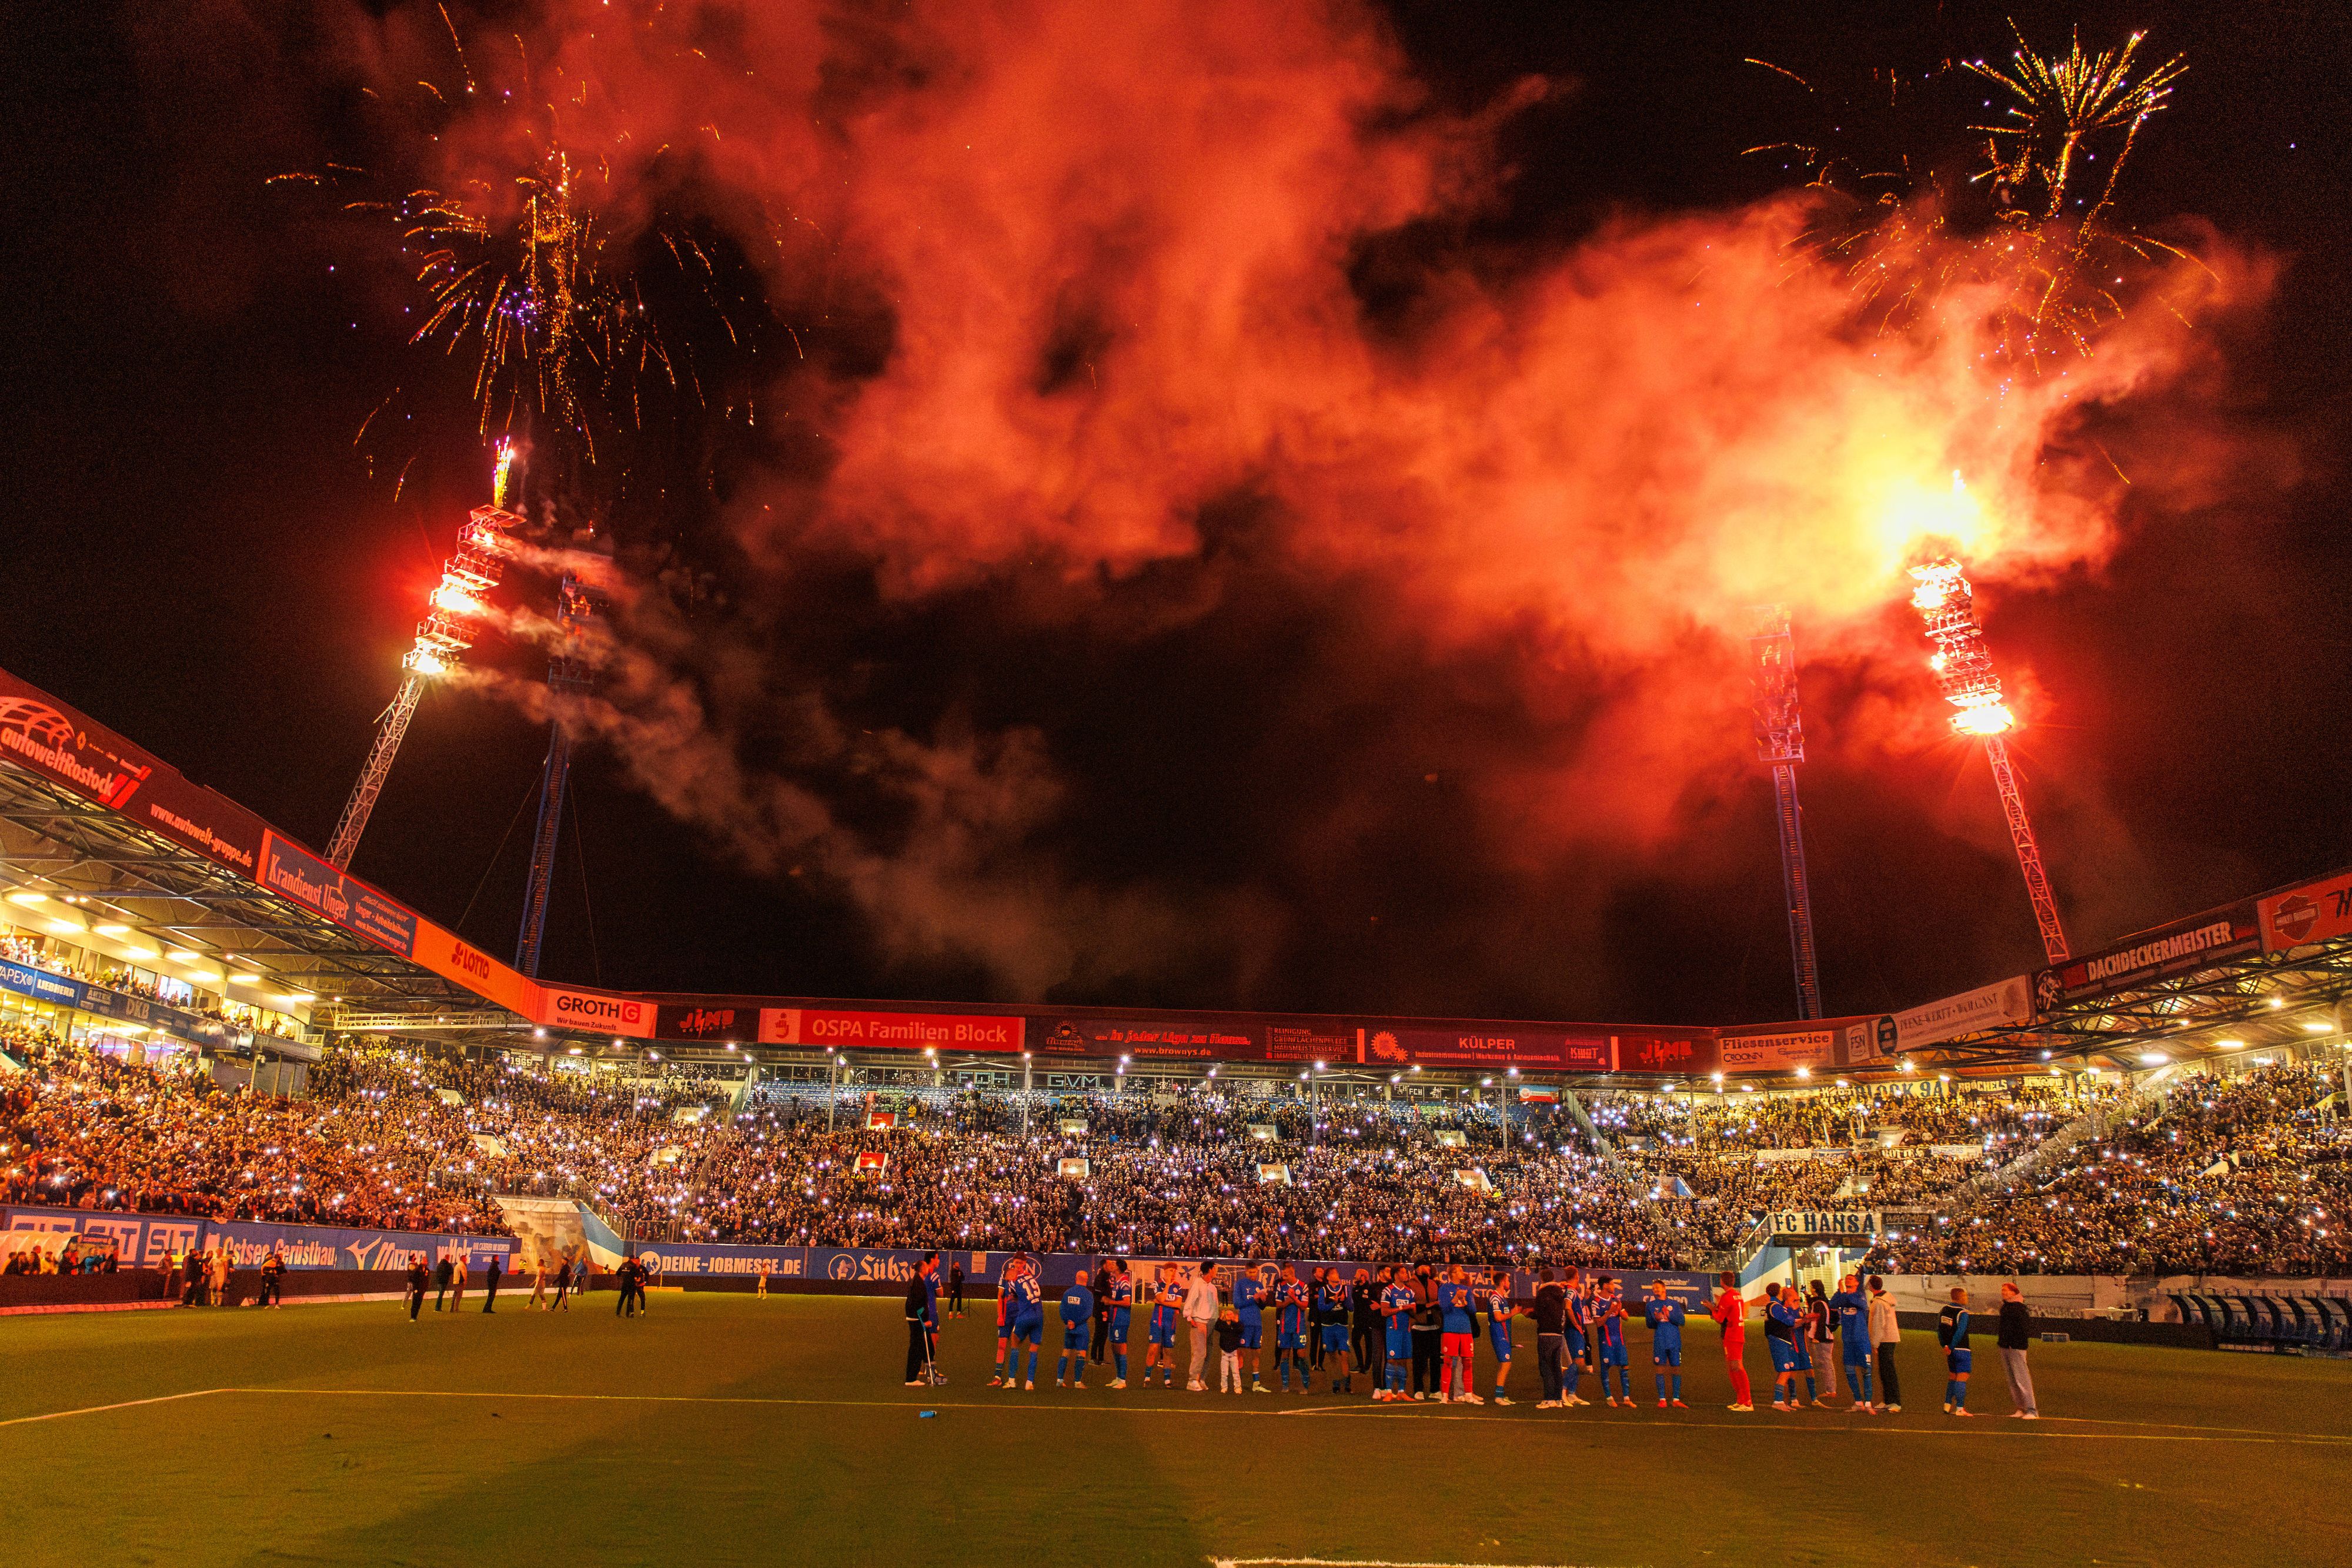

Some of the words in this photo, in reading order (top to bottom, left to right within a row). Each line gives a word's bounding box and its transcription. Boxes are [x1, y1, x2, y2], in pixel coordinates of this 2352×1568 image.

[1, 727, 116, 798] autoweltRostock
[151, 803, 253, 868] www.autowelt-gruppe.de
[268, 853, 323, 907] Krandienst
[323, 883, 349, 921] Unger
[2087, 921, 2234, 982] DACHDECKERMEISTER
[463, 948, 490, 979] LOTTO
[0, 965, 26, 986] APEX
[36, 978, 75, 998] LIEBHERR
[557, 995, 620, 1018] GROTH
[812, 1019, 864, 1038] OSPA
[869, 1021, 949, 1041] Familien
[955, 1024, 1007, 1043] Block
[1124, 1029, 1161, 1044] jeder
[1162, 1031, 1189, 1045] Liga
[1191, 1034, 1207, 1044] zu
[1134, 1047, 1212, 1057] www.brownys.de
[1274, 1044, 1348, 1052] HAUSMEISTERSERVICE
[1458, 1033, 1515, 1051] KÜLPER
[1722, 1034, 1829, 1050] Fliesenservice
[1274, 1052, 1341, 1061] IMMOBILIENSERVICE
[1048, 1075, 1099, 1088] GVM
[1919, 1081, 1945, 1098] 9A
[1775, 1212, 1797, 1233] FC
[1804, 1212, 1876, 1233] HANSA
[148, 1229, 195, 1256] SLT
[662, 1255, 801, 1275] DEINE-JOBMESSE.DE
[857, 1250, 914, 1282] Lübz
[1022, 1278, 1041, 1301] 19
[1739, 1300, 1743, 1322] 1
